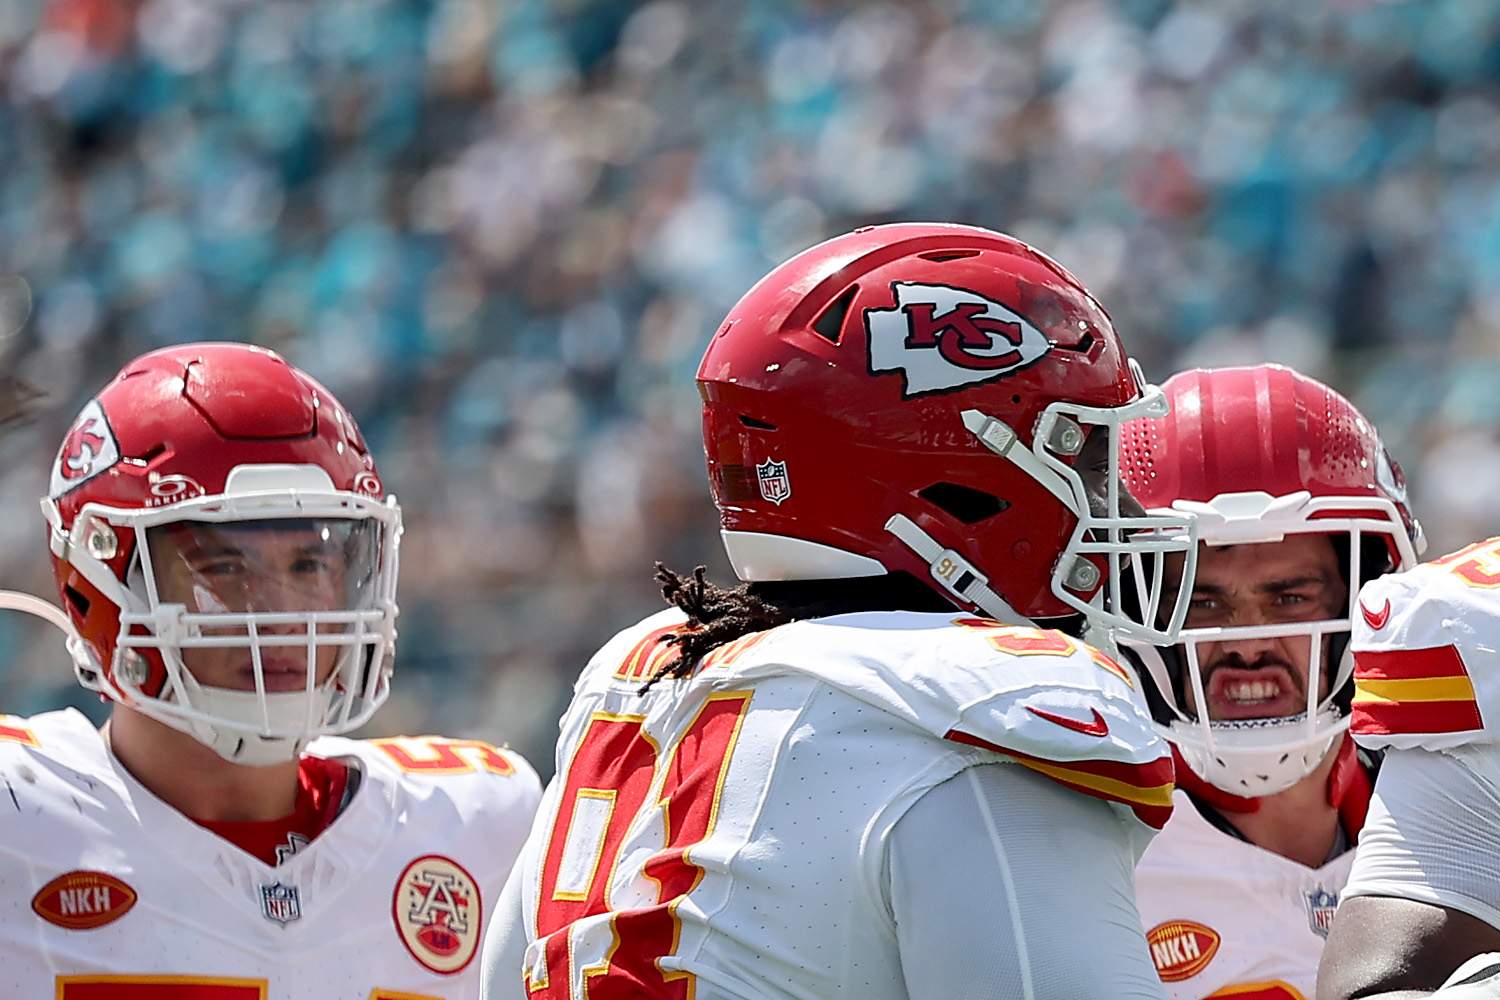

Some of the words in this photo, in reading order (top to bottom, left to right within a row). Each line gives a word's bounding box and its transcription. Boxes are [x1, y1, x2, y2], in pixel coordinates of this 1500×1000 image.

[903, 301, 1023, 368] KC
[761, 478, 787, 500] NFL
[936, 557, 959, 580] 91
[60, 886, 108, 915] NKH
[1149, 931, 1199, 969] NKH
